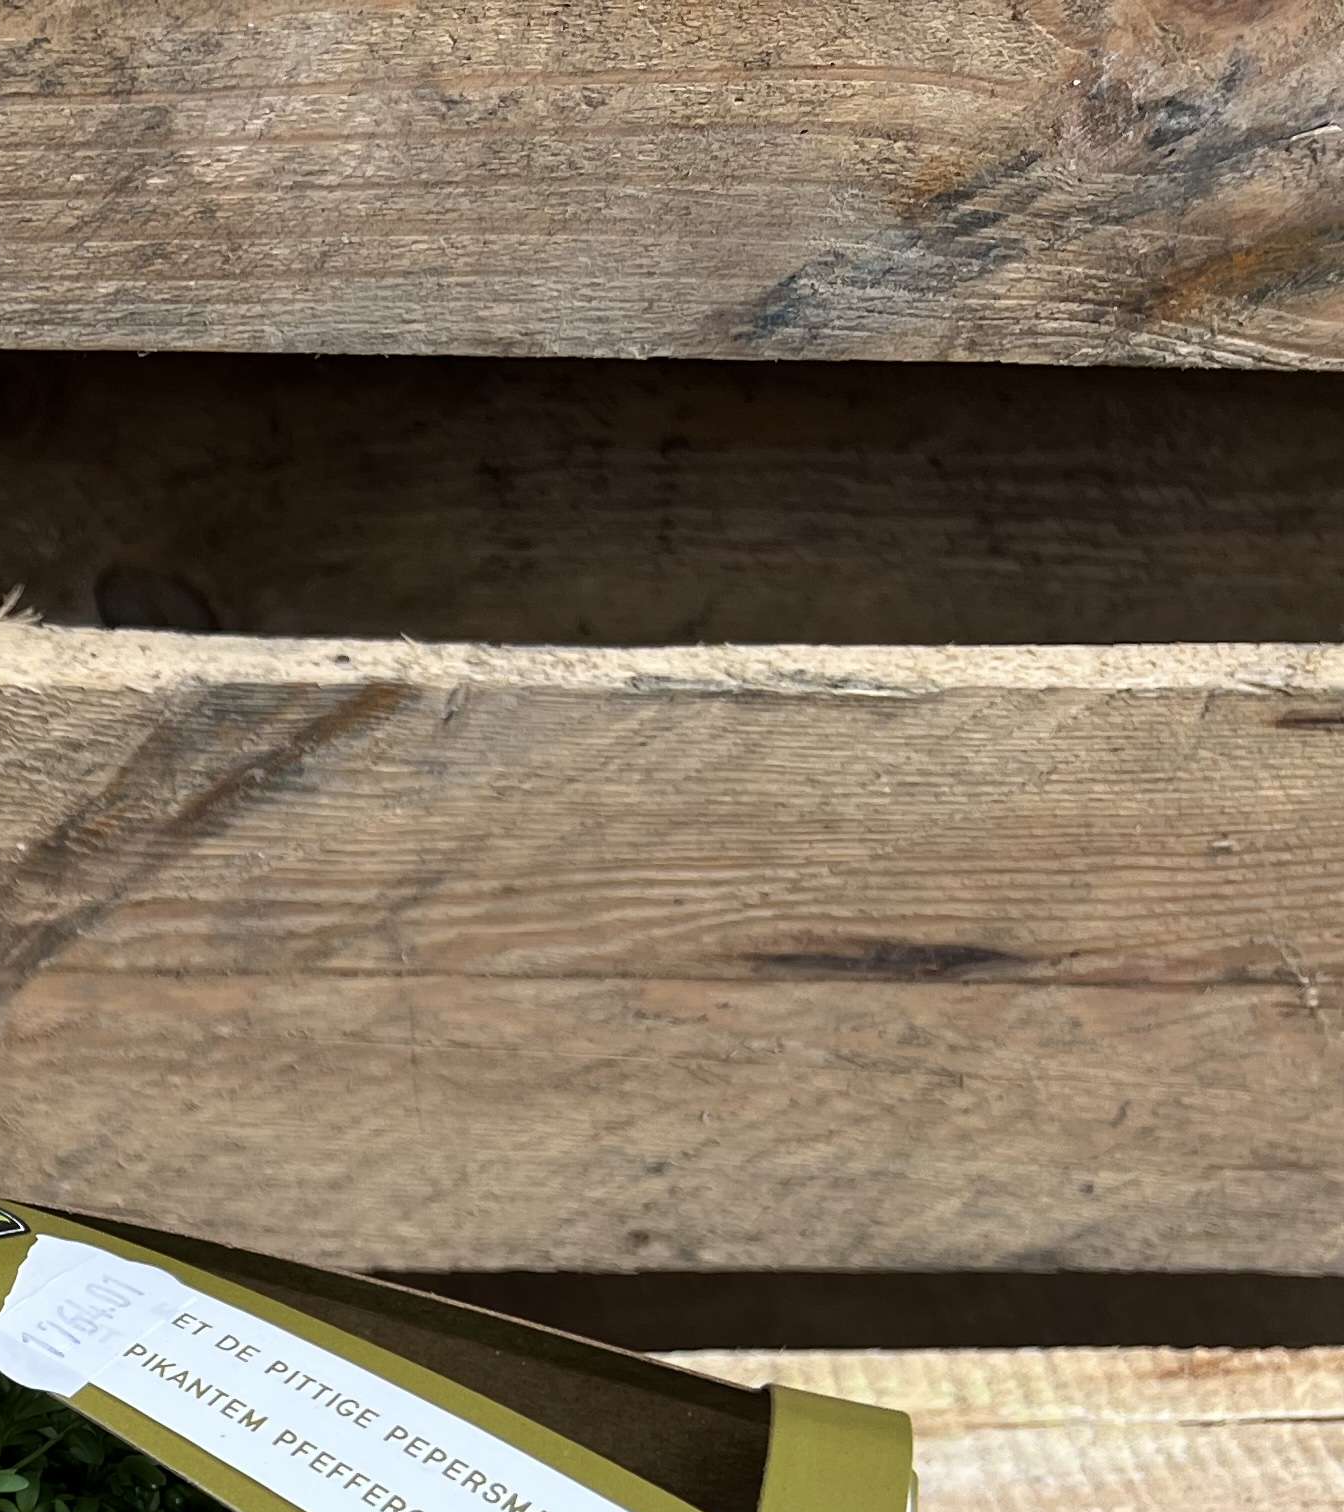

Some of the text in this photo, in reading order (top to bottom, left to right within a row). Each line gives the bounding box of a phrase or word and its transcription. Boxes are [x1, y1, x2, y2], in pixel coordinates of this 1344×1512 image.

[122, 1343, 269, 1433] PIKANTEM
[171, 1312, 212, 1337] ET
[214, 1334, 261, 1364] DE
[265, 1359, 382, 1430] PITTIGE
